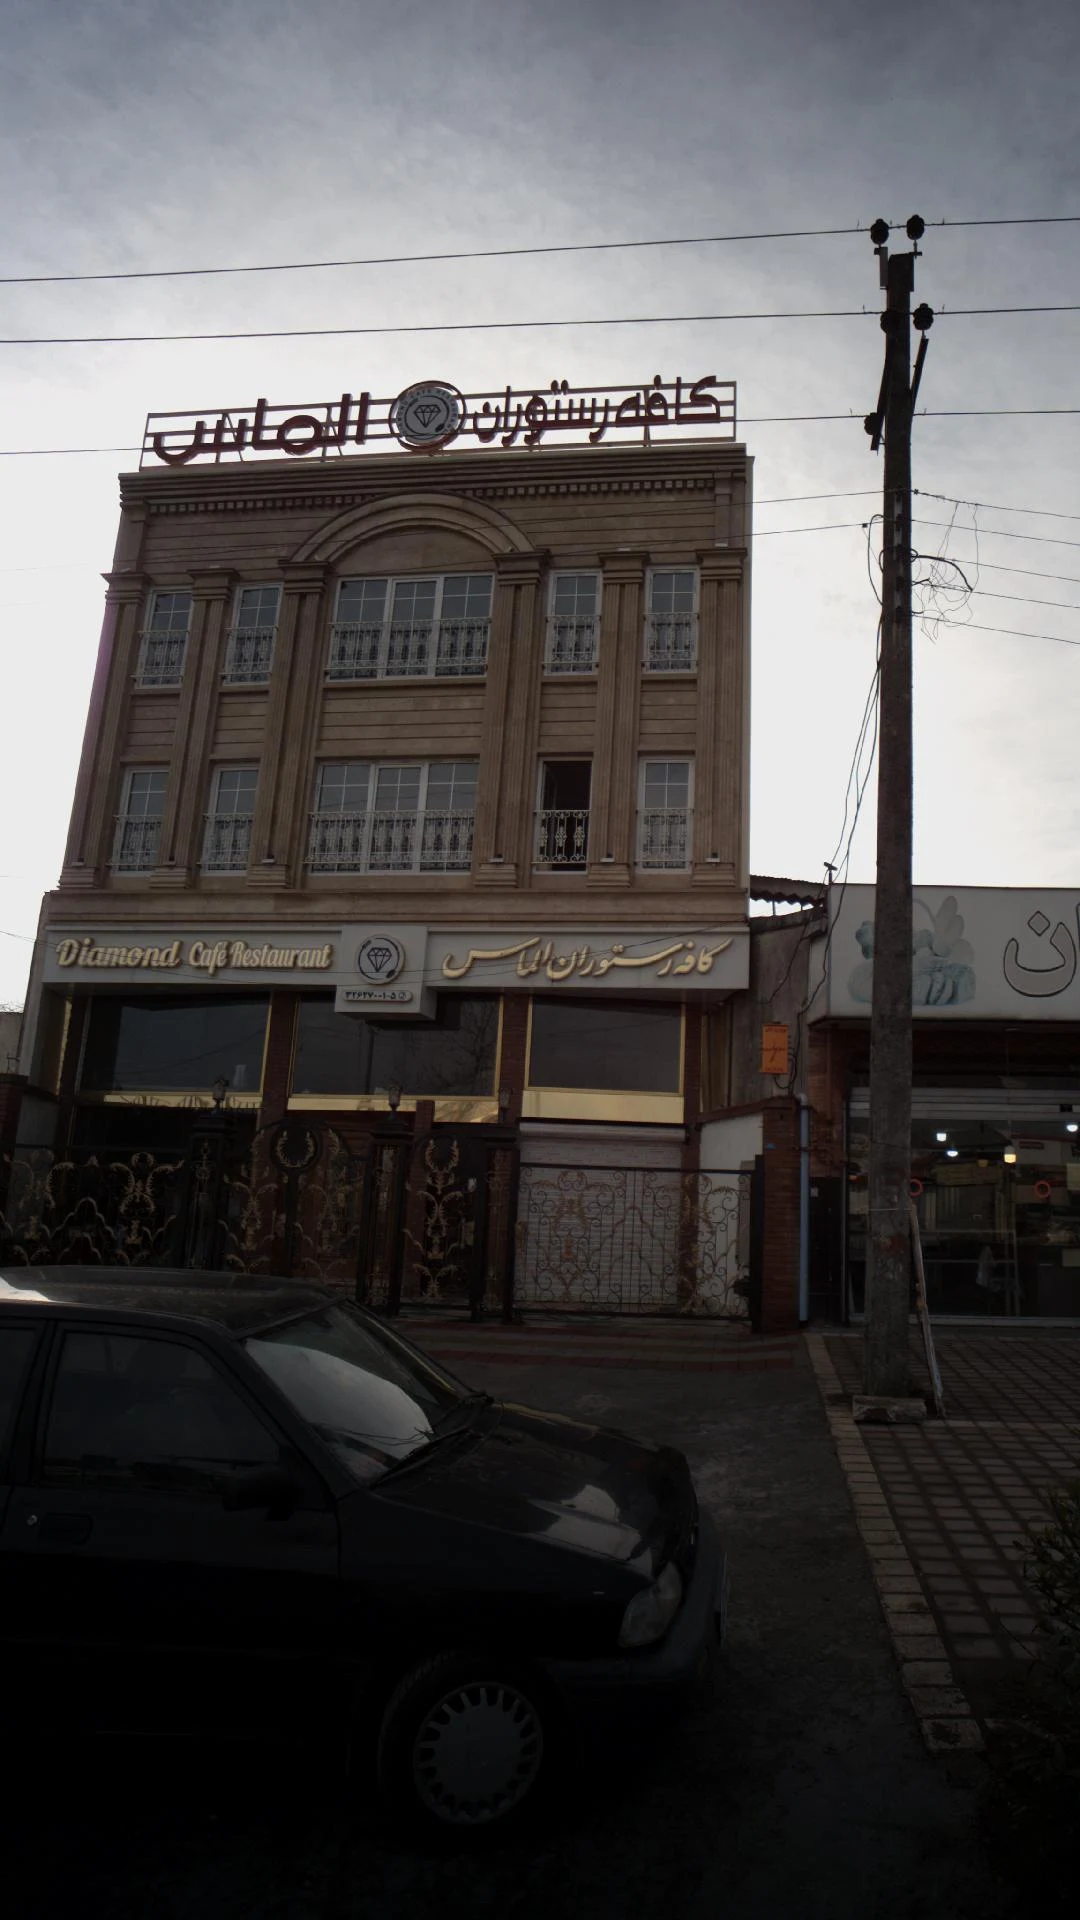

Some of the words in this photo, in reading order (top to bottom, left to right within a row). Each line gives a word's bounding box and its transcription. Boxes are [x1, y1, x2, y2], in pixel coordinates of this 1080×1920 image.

[473, 379, 610, 447] رستوران
[615, 375, 721, 426] کافه
[153, 392, 371, 467] الماس
[56, 936, 182, 968] Diamond
[230, 941, 333, 969] Restaurant
[441, 936, 555, 979] الماس
[546, 941, 686, 981] رستوران
[673, 937, 735, 976] کافه
